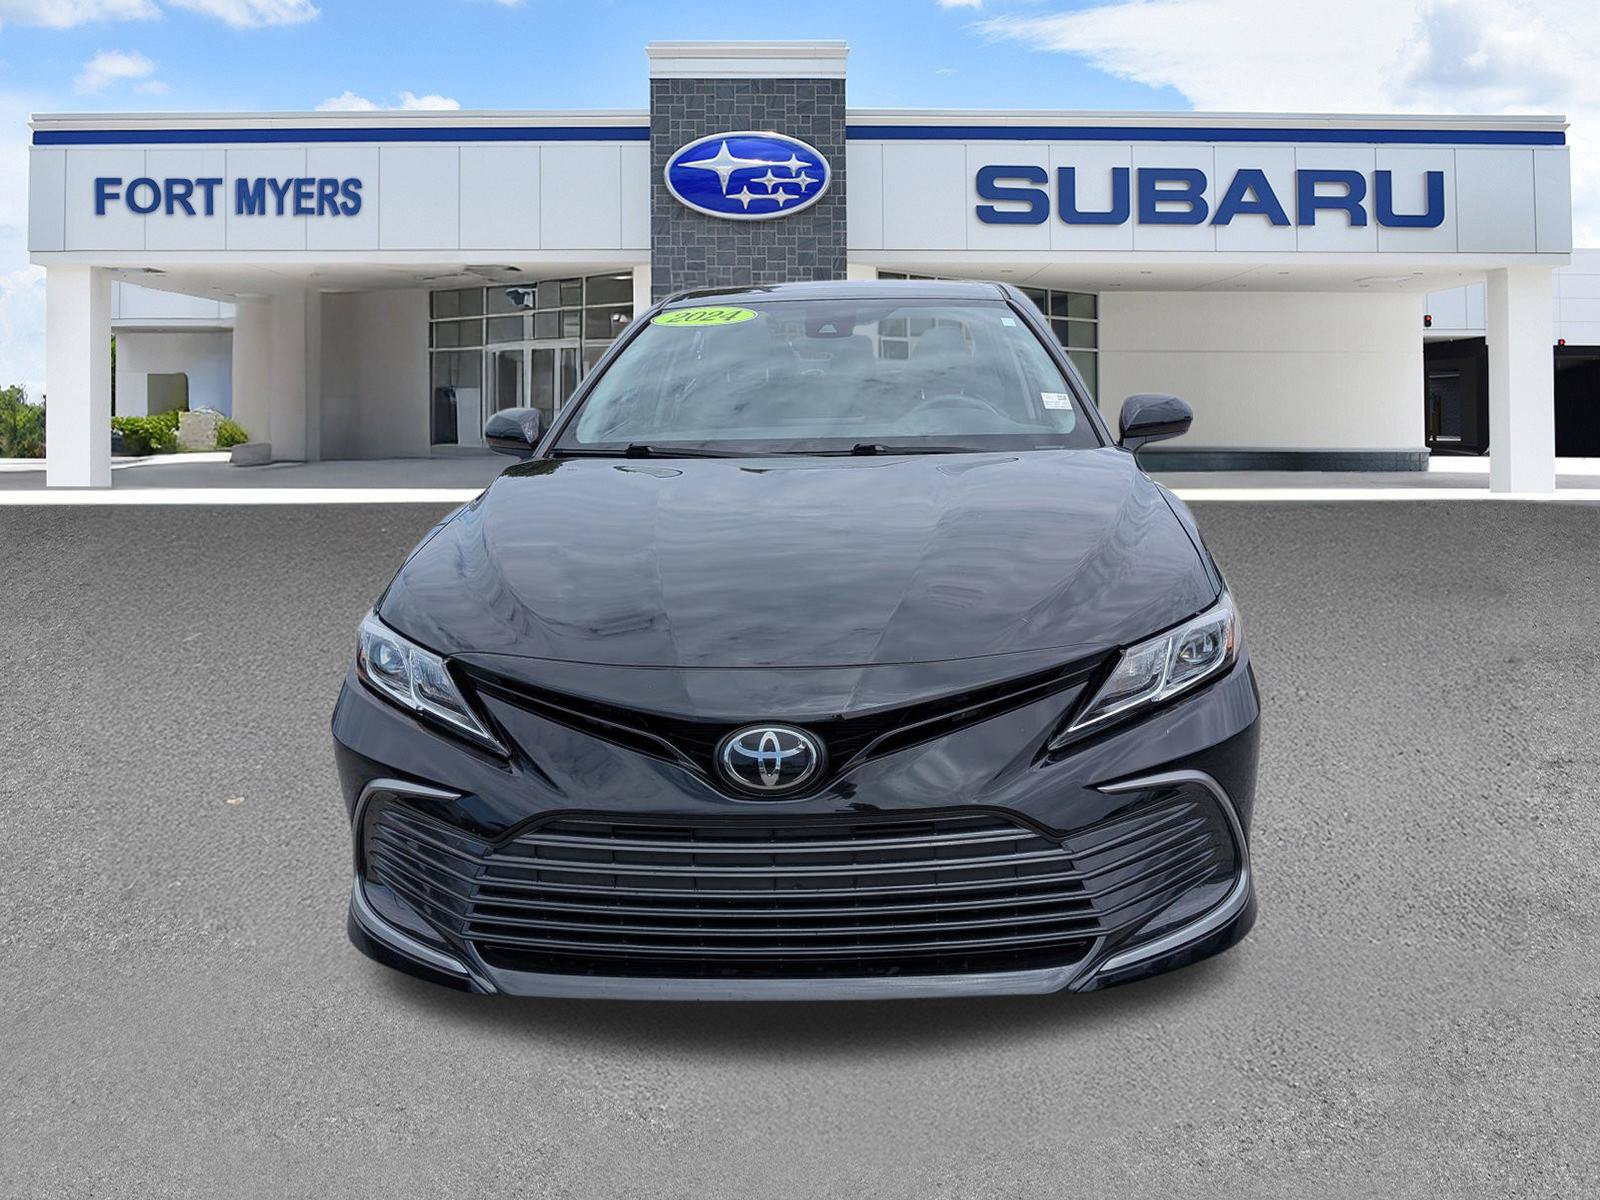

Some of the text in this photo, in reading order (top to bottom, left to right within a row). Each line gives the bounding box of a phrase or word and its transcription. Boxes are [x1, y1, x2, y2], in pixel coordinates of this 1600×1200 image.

[94, 177, 363, 217] FORT MYERS
[975, 165, 1446, 228] SUBARU
[666, 310, 743, 323] 2024
